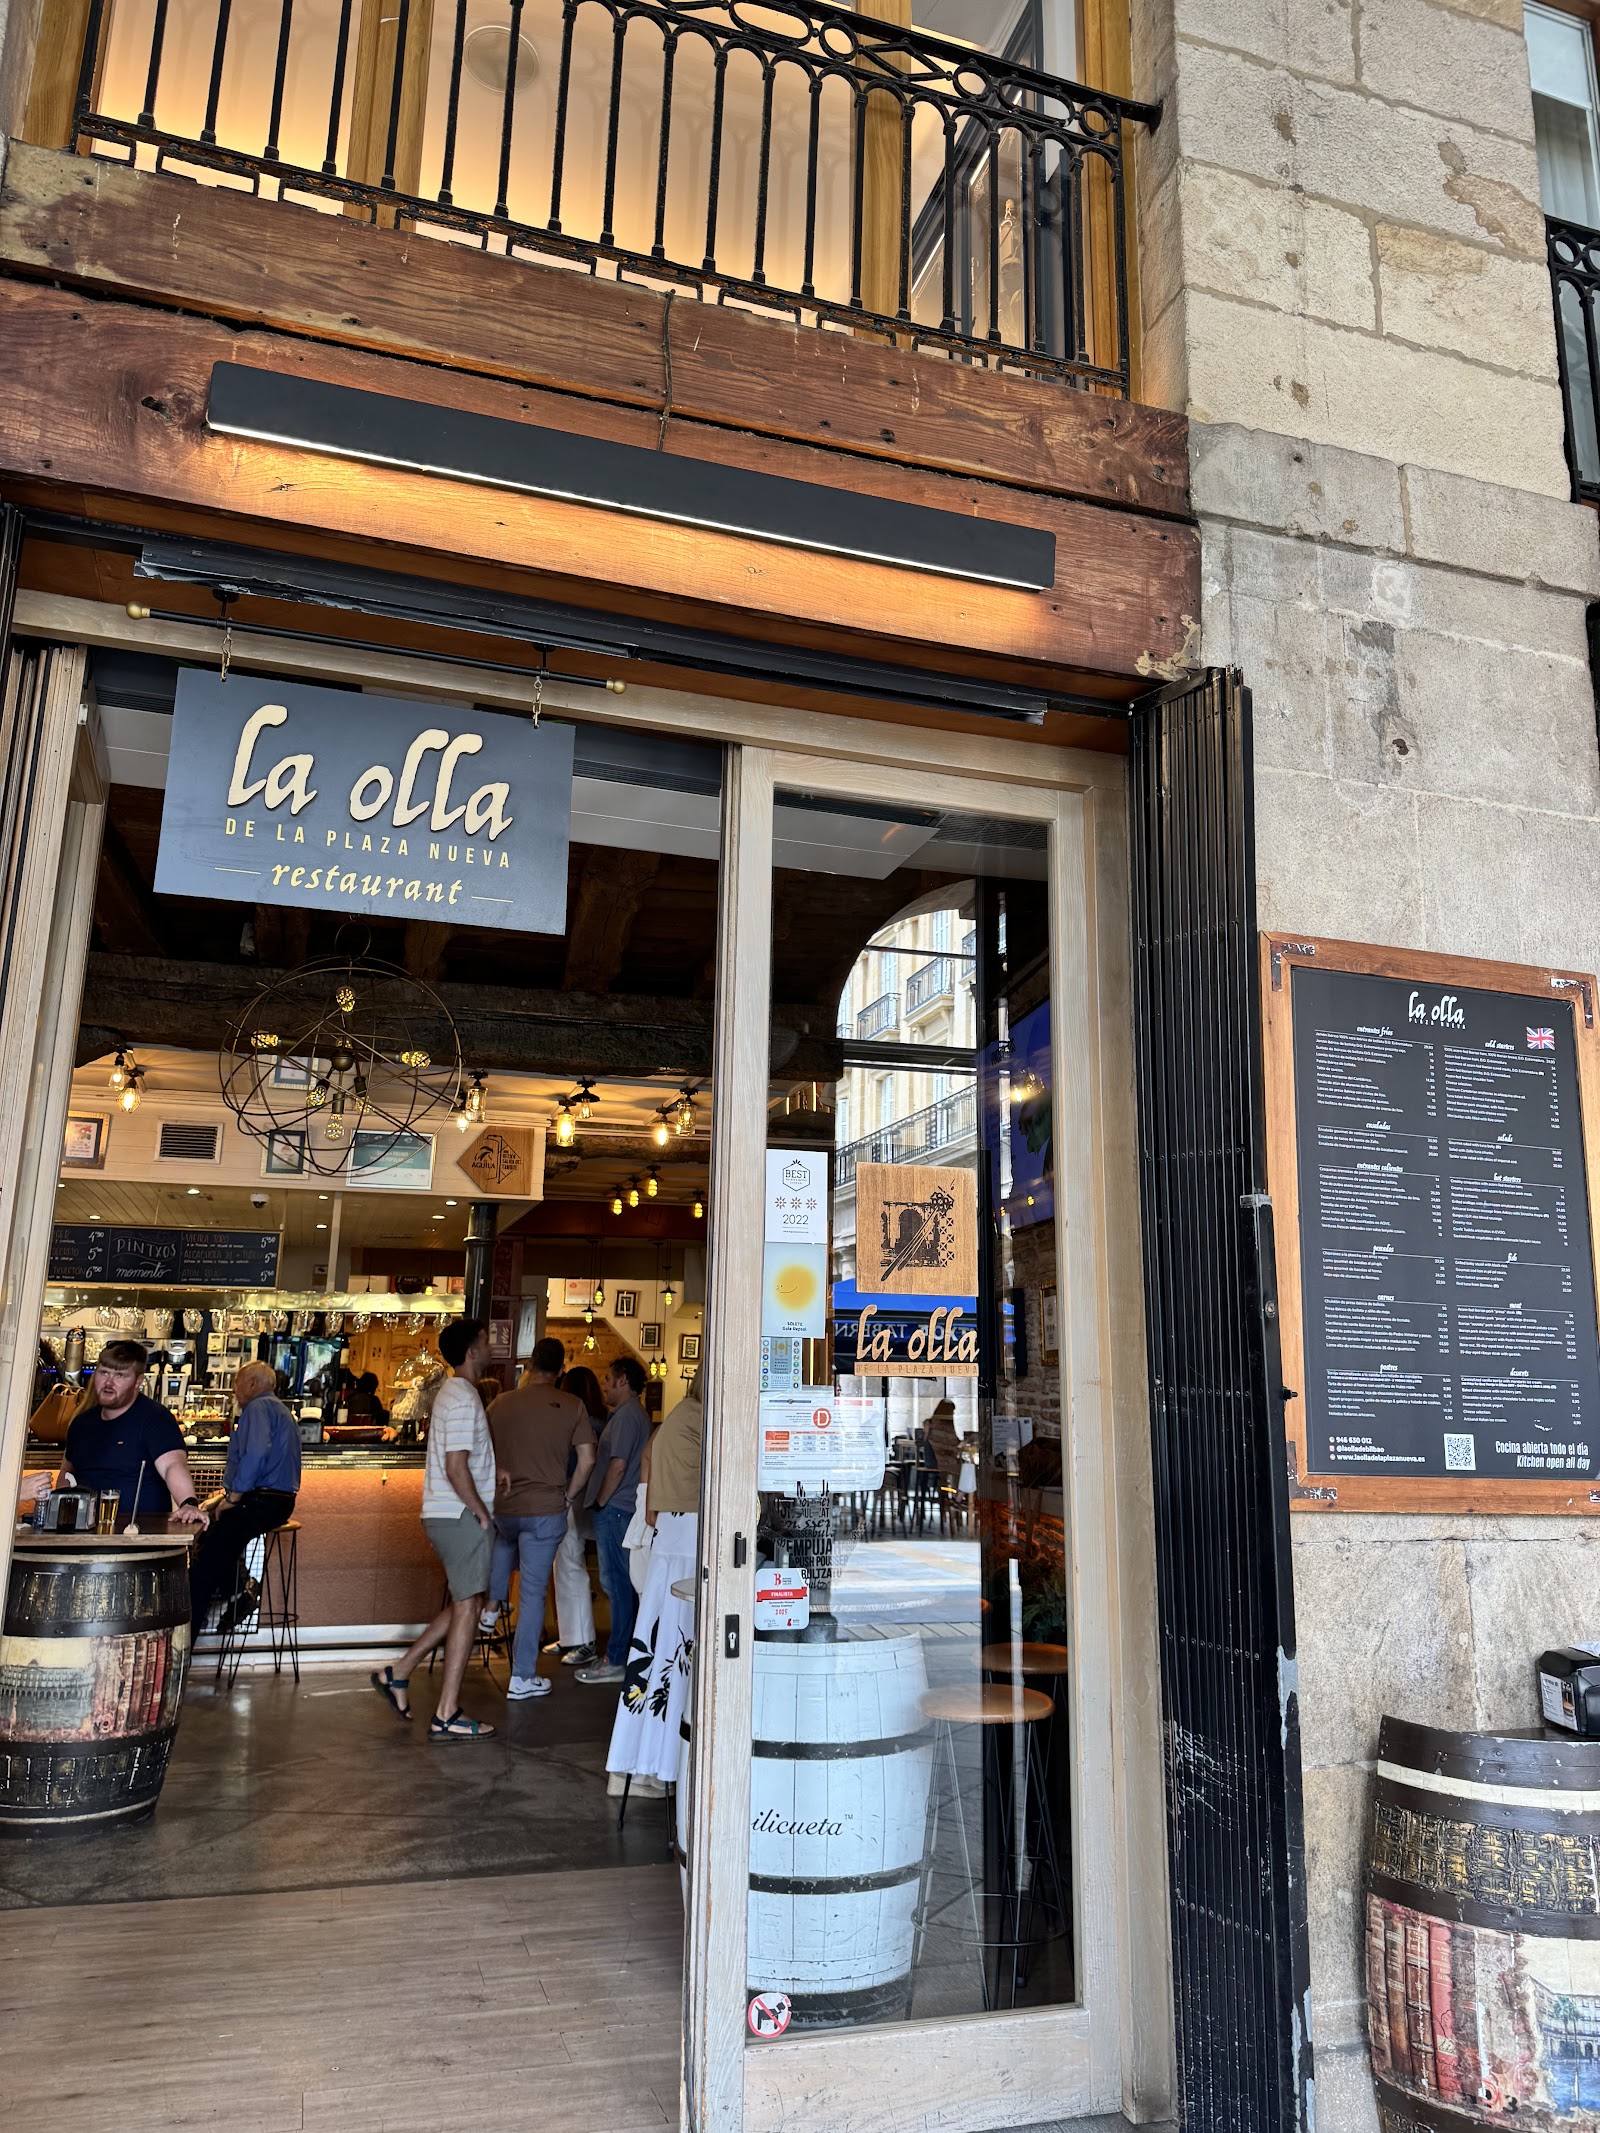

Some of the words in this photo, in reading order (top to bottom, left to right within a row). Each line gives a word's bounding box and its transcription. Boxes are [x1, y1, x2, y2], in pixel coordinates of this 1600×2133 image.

[228, 704, 318, 816] la
[349, 728, 515, 841] olla
[225, 818, 256, 838] DE
[276, 824, 306, 844] LA
[326, 830, 410, 856] PLAZA
[429, 843, 511, 869] NUEVA
[271, 864, 463, 906] restaurant
[1408, 991, 1426, 1020] la
[1431, 996, 1465, 1024] olla
[1484, 1038, 1496, 1048] cold
[1496, 1132, 1513, 1143] salads
[785, 1170, 807, 1178] BEST
[1493, 1172, 1502, 1181] hot
[783, 1214, 808, 1225] 2022
[1372, 1242, 1394, 1256] pescados
[1505, 1252, 1518, 1264] fish
[1377, 1293, 1394, 1301] carnes
[856, 1304, 893, 1362] la
[908, 1307, 980, 1362] olla
[856, 1365, 869, 1374] DE
[877, 1365, 890, 1374] LA
[899, 1365, 934, 1374] PLAZA
[941, 1365, 977, 1374] NUEVA
[817, 1410, 829, 1426] D
[1496, 1440, 1520, 1454] Cocina
[1522, 1442, 1548, 1454] abierta
[1550, 1442, 1566, 1455] todo
[1568, 1443, 1574, 1455] el
[1576, 1441, 1588, 1456] día
[1517, 1455, 1544, 1468] Kitchen
[1546, 1457, 1564, 1469] open
[1566, 1457, 1575, 1468] all
[1577, 1458, 1590, 1470] day
[787, 1538, 833, 1556] EMPUJA
[796, 1556, 816, 1566] PUSH
[751, 1809, 843, 1835] ilicueta
